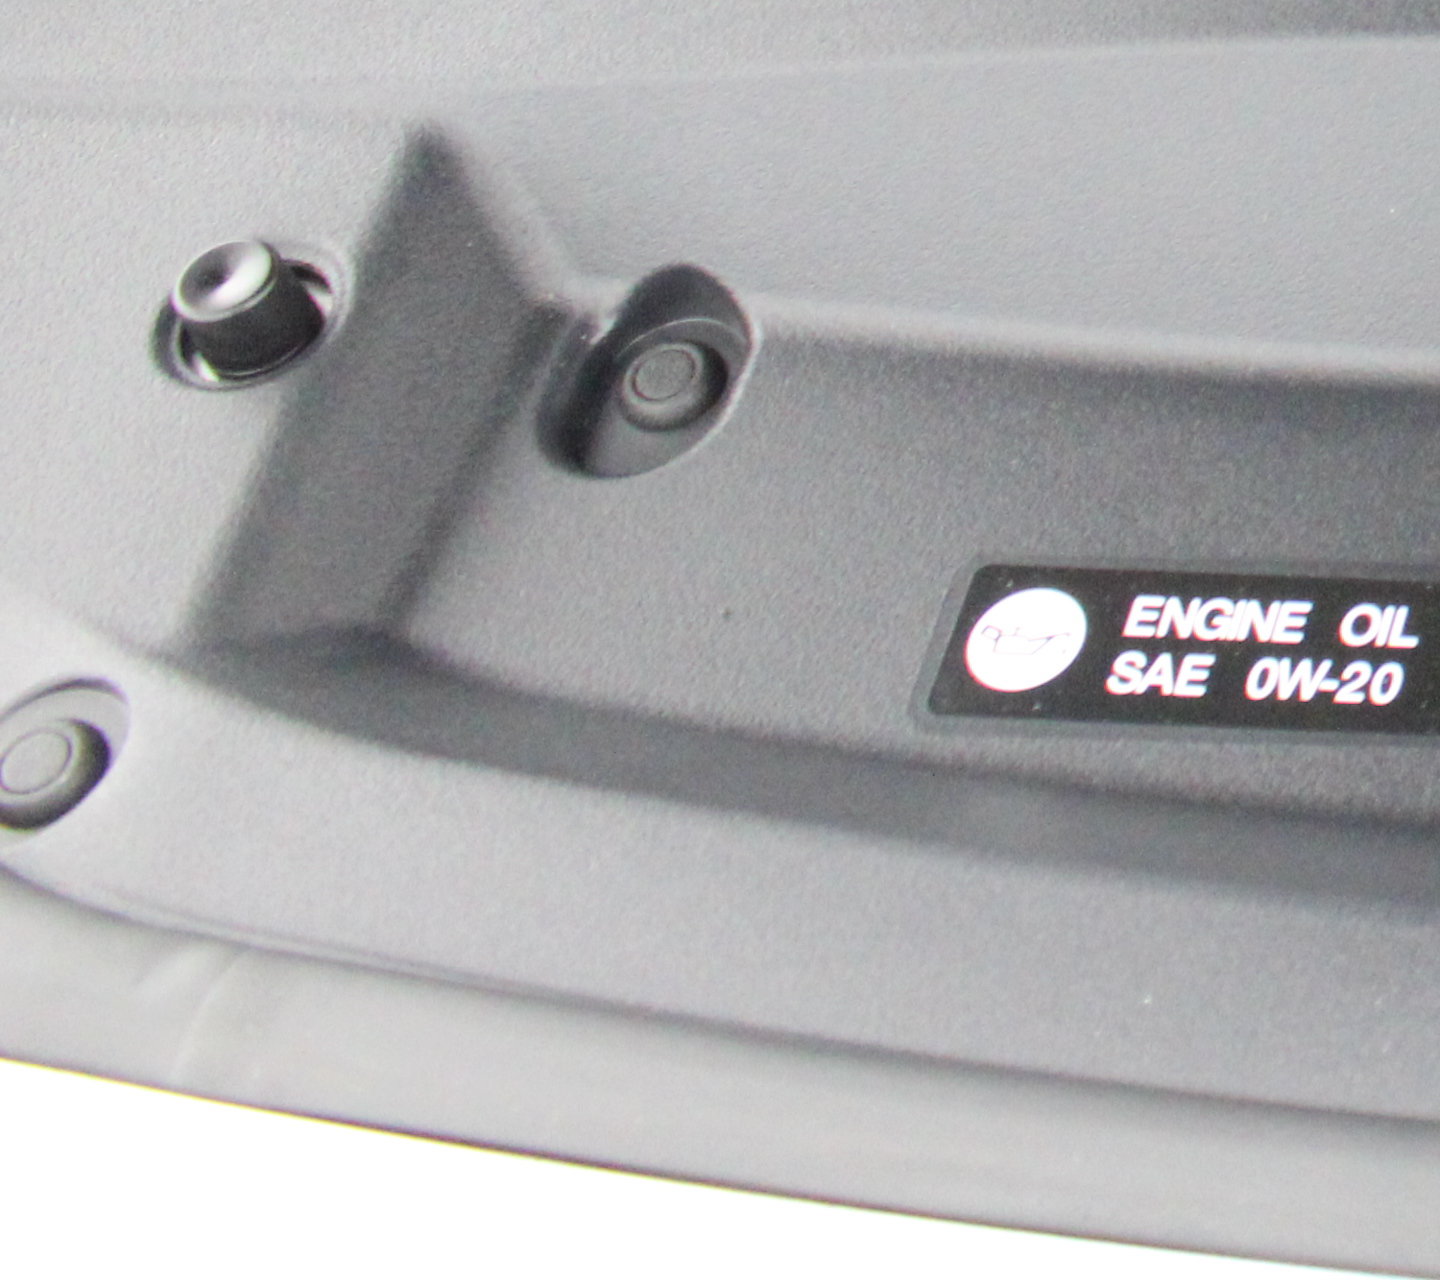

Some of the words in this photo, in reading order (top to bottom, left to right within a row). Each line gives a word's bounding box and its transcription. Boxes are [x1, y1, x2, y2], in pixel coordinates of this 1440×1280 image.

[1121, 594, 1314, 644] ENGINE
[1338, 602, 1420, 650] OIL
[1105, 650, 1217, 698] SAE
[1244, 656, 1405, 707] 0W-20
